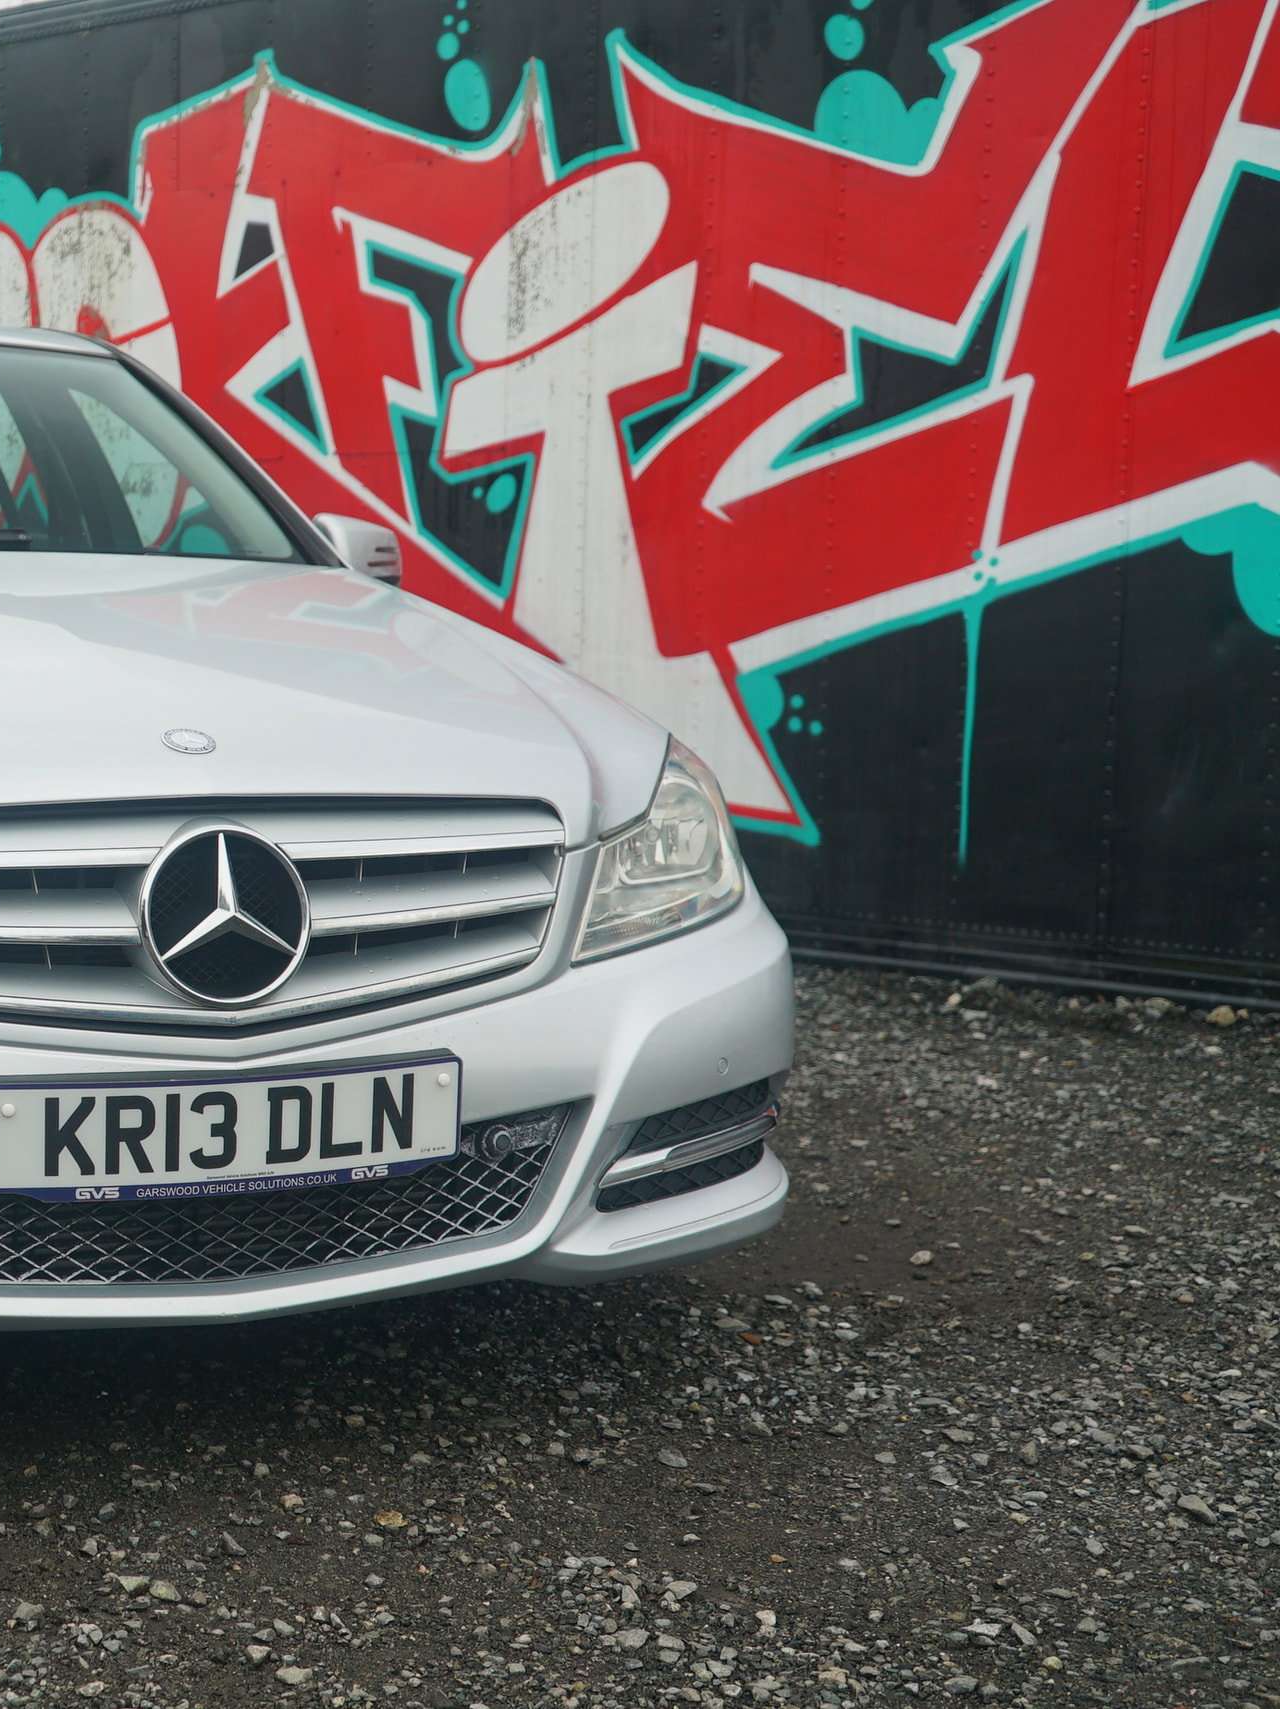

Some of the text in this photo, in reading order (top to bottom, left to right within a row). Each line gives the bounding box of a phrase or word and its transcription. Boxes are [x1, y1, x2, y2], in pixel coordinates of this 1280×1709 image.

[44, 1073, 416, 1177] KR13 DLN
[351, 1164, 390, 1180] GVS
[75, 1186, 120, 1200] GVS
[136, 1186, 200, 1198] GARSWOOD
[201, 1182, 246, 1195] VEHICLE
[248, 1173, 337, 1192] SOLUTIONS.CO.UK
